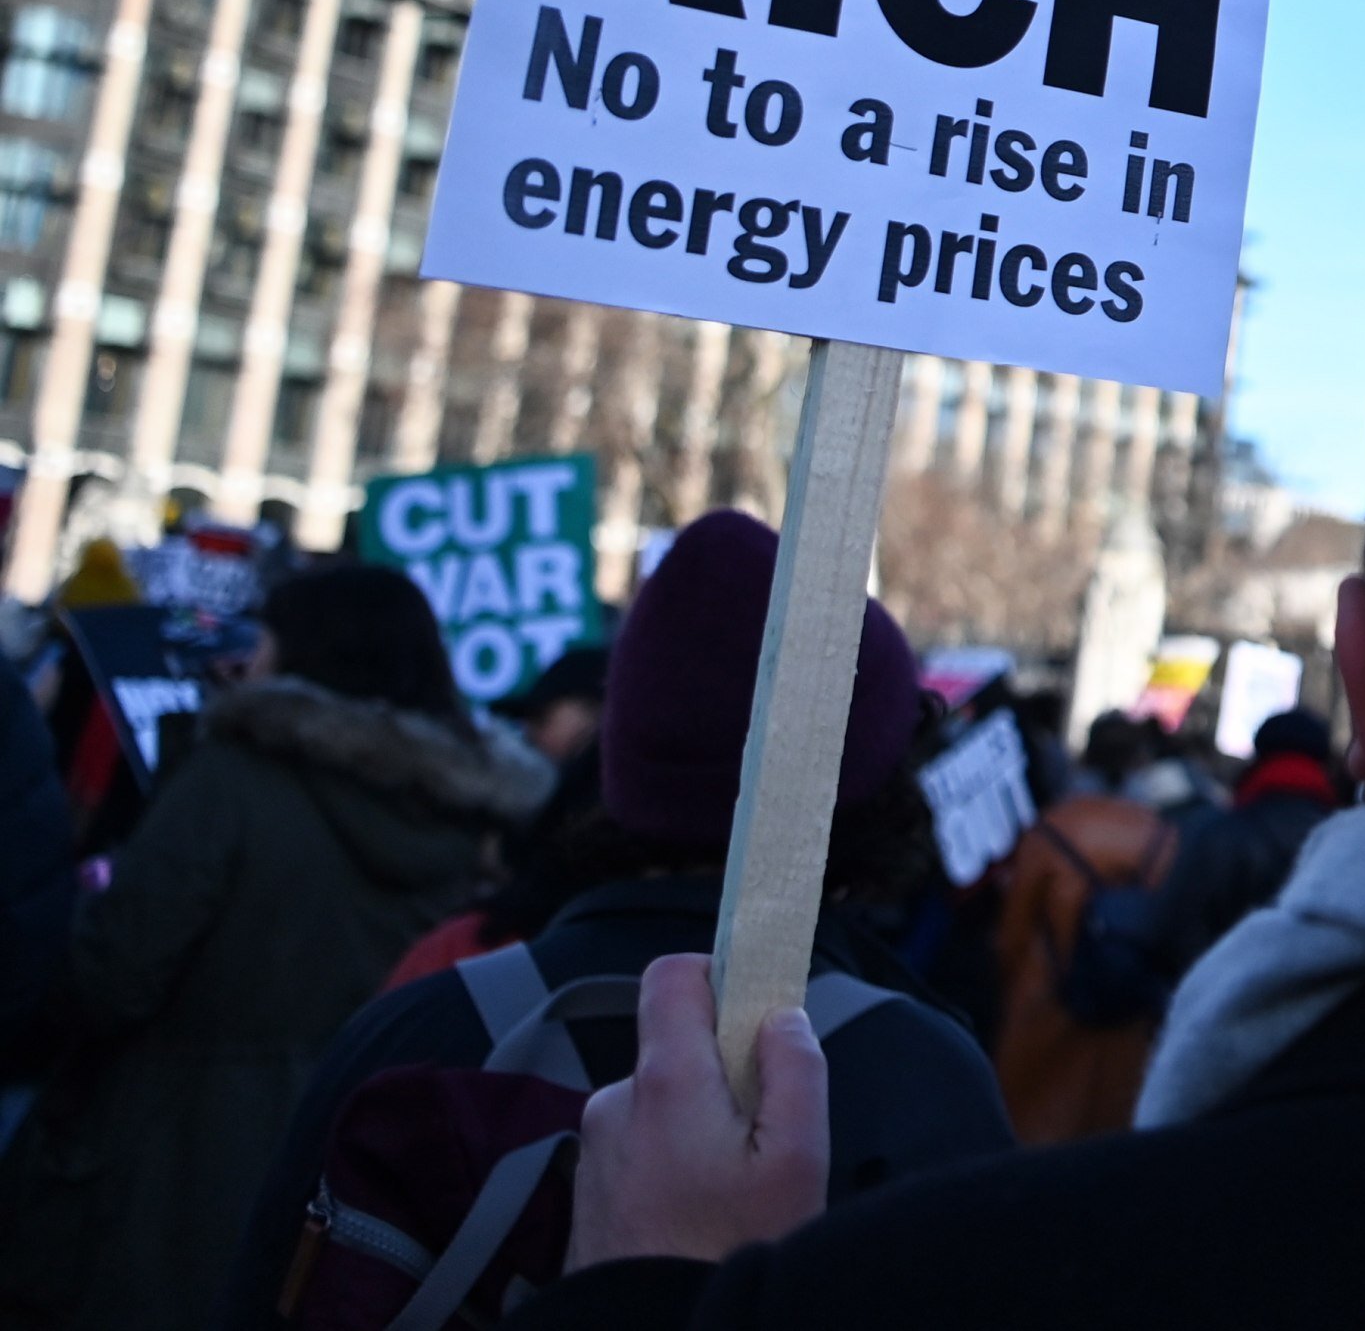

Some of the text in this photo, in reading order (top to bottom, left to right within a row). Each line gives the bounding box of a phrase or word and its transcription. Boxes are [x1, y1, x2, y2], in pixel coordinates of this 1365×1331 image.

[522, 5, 1195, 224] No to a rise in
[503, 157, 1145, 323] energy prices
[379, 463, 578, 558] CUT
[446, 616, 584, 704] OT
